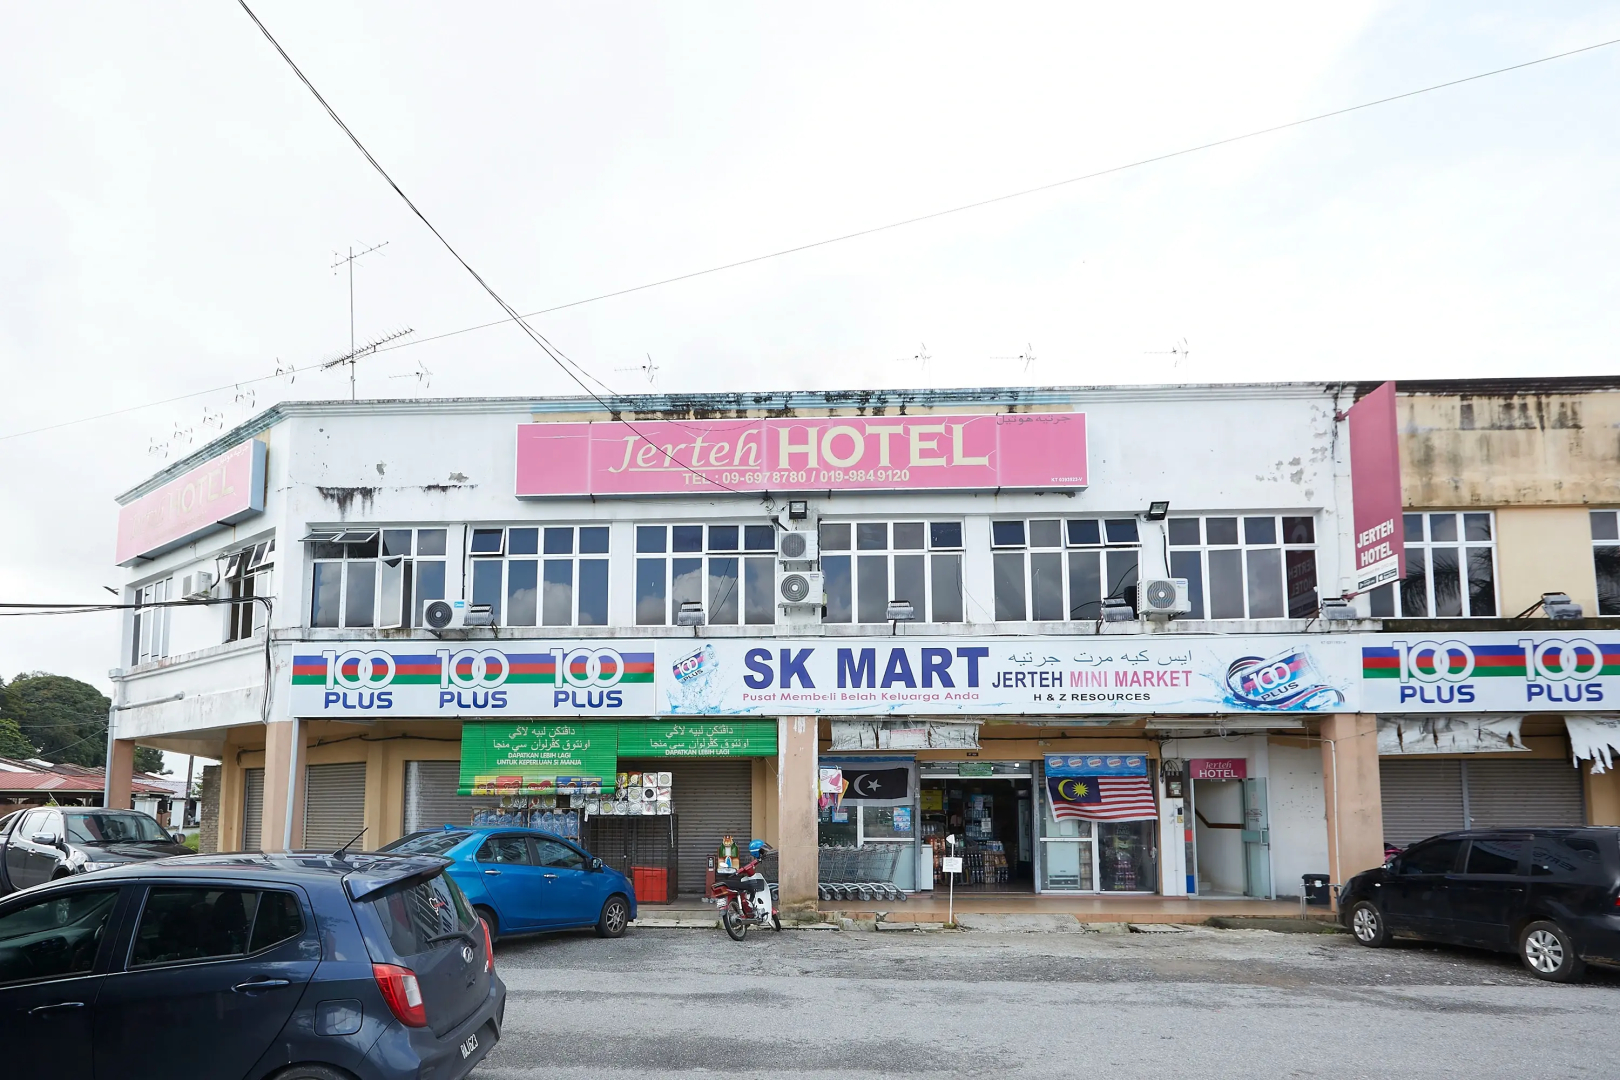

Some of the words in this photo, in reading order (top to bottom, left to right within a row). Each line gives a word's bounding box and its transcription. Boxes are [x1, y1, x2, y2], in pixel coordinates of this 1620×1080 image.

[608, 429, 762, 473] Jerteh
[777, 424, 989, 469] HOTEL
[682, 473, 712, 485] TEL
[167, 465, 235, 519] HOTEL
[1357, 518, 1394, 548] JERTEH
[1361, 541, 1392, 566] HOTEL
[322, 649, 396, 690] 100
[436, 648, 510, 690] 100
[550, 648, 625, 689] 100
[676, 656, 698, 676] 100
[743, 647, 816, 690] SK
[836, 646, 990, 690] MART
[1392, 640, 1476, 683] 100
[1518, 638, 1604, 682] 100
[682, 670, 703, 681] PLUS
[992, 671, 1063, 688] JERTEH
[1070, 671, 1108, 687] MINI
[1114, 670, 1192, 687] MARKET
[1249, 662, 1291, 694] 100
[324, 692, 393, 709] PLUS
[439, 691, 507, 708] PLUS
[554, 690, 623, 708] PLUS
[743, 693, 776, 701] Pusat
[780, 692, 836, 701] Membeli
[841, 692, 876, 701] Belah
[881, 692, 939, 702] Keluarga
[944, 692, 979, 700] Anda
[1033, 693, 1041, 701] H
[1071, 693, 1151, 701] RESOURCES
[1261, 682, 1299, 701] PLUS
[1400, 685, 1475, 704] PLUS
[1527, 683, 1604, 702] PLUS
[1206, 760, 1232, 769] Jerteh
